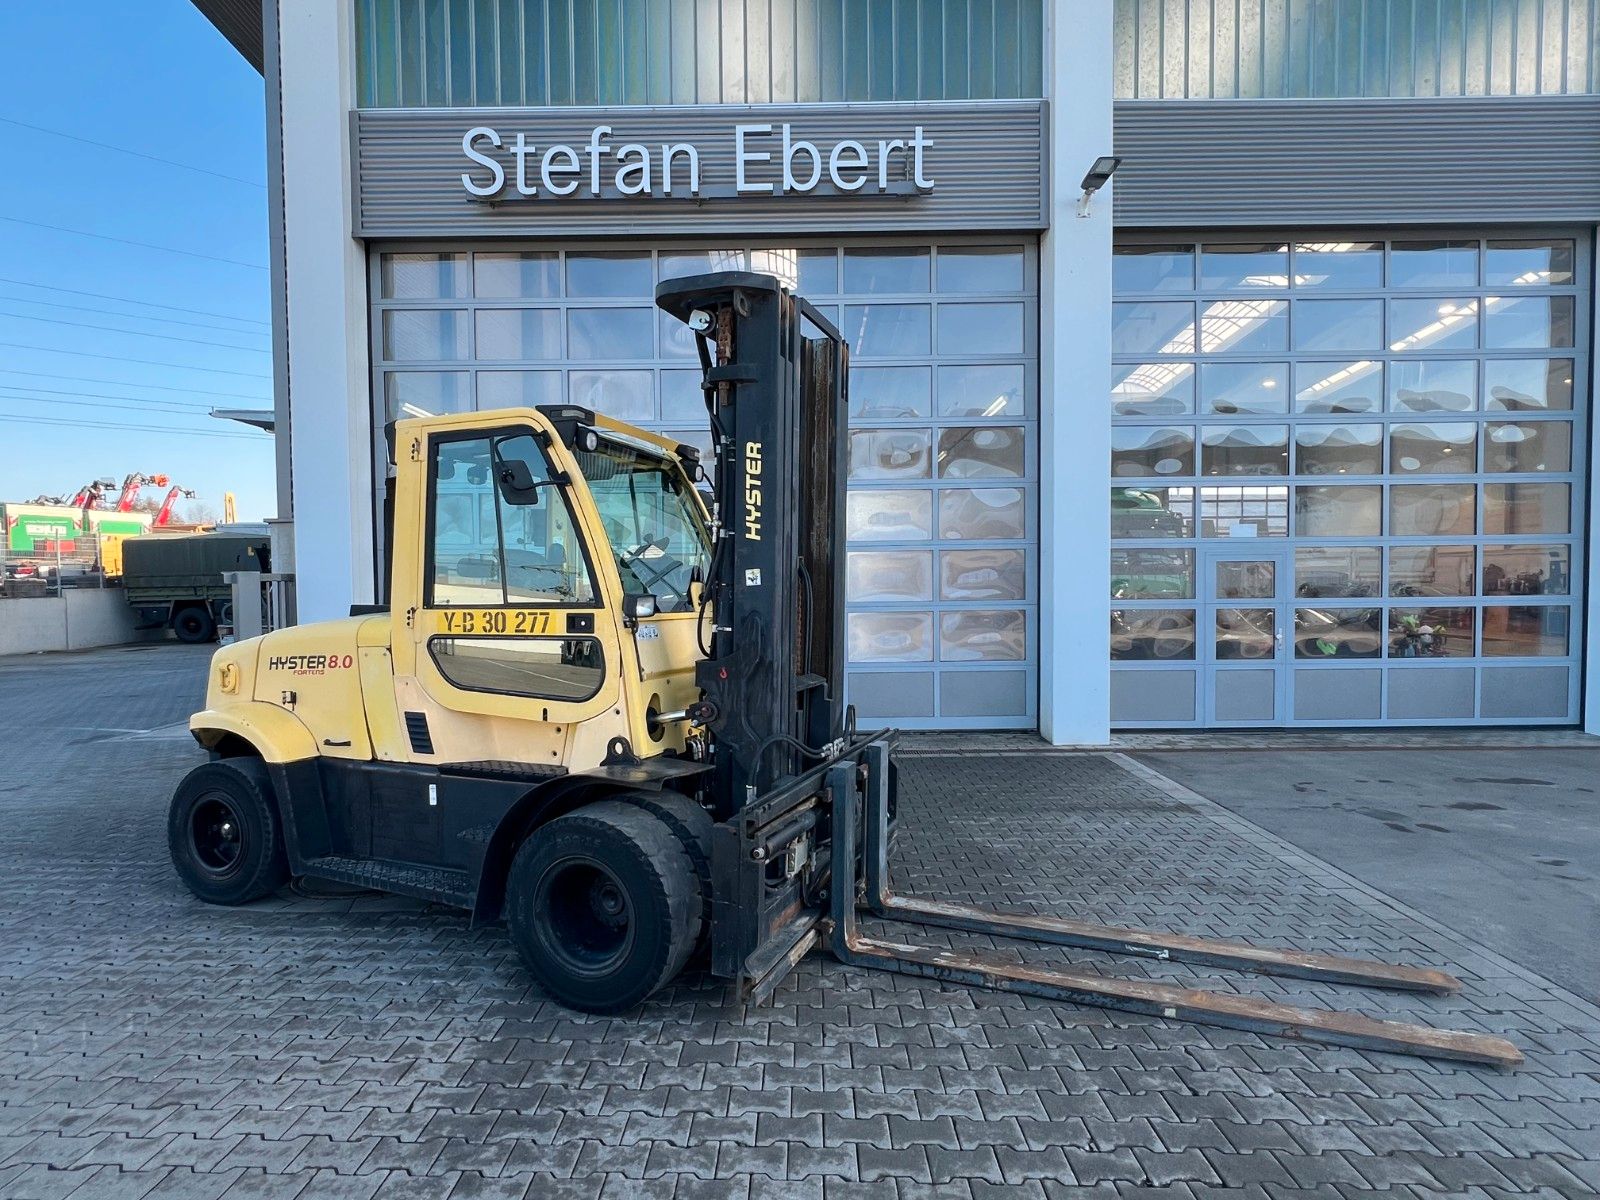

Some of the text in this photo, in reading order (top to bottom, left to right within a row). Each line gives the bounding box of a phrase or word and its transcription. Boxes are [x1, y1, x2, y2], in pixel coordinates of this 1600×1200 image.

[462, 124, 935, 196] Stefan Ebert
[745, 441, 762, 541] HYSTER
[444, 611, 550, 633] Y-B 30 277
[269, 655, 353, 671] HYSTER 8.0
